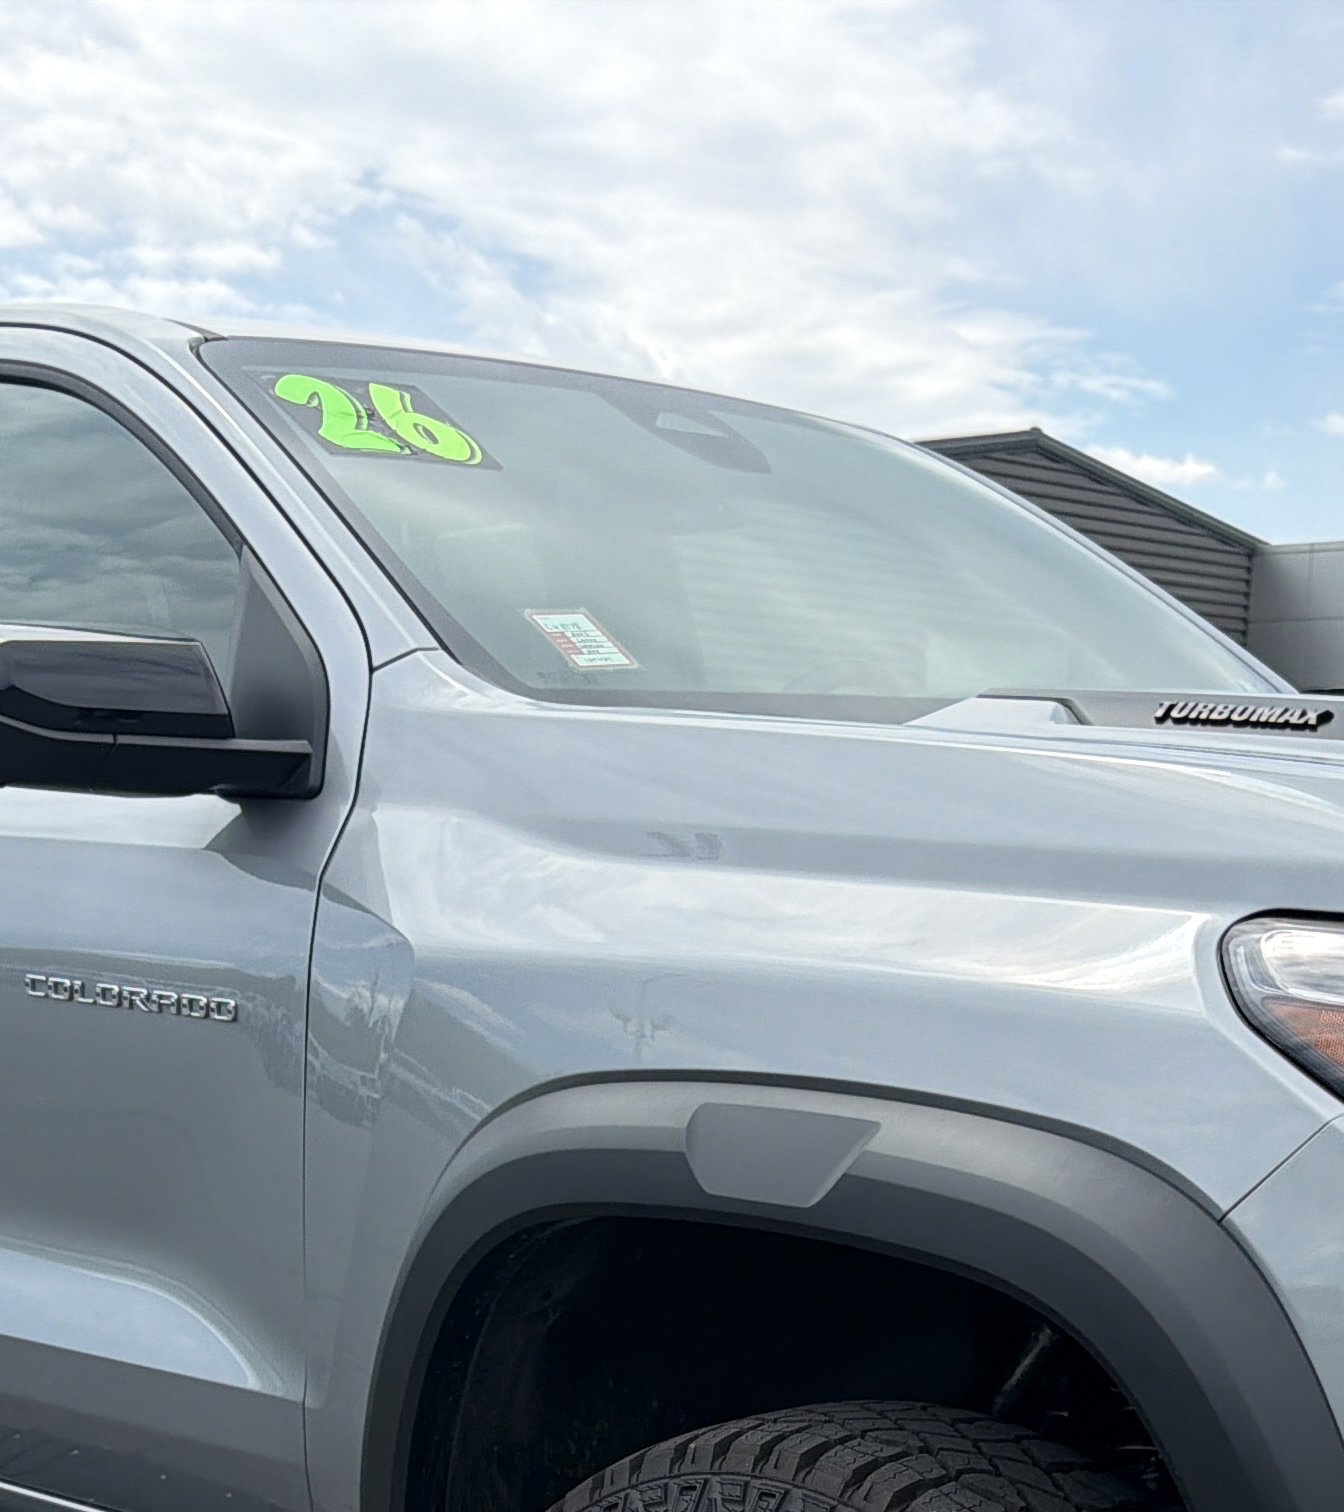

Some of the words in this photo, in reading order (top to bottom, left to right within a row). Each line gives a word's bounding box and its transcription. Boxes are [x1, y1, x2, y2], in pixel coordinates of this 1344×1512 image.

[274, 372, 483, 465] 26
[1153, 701, 1334, 732] TURBOMAX
[24, 973, 239, 1022] COLORADO
